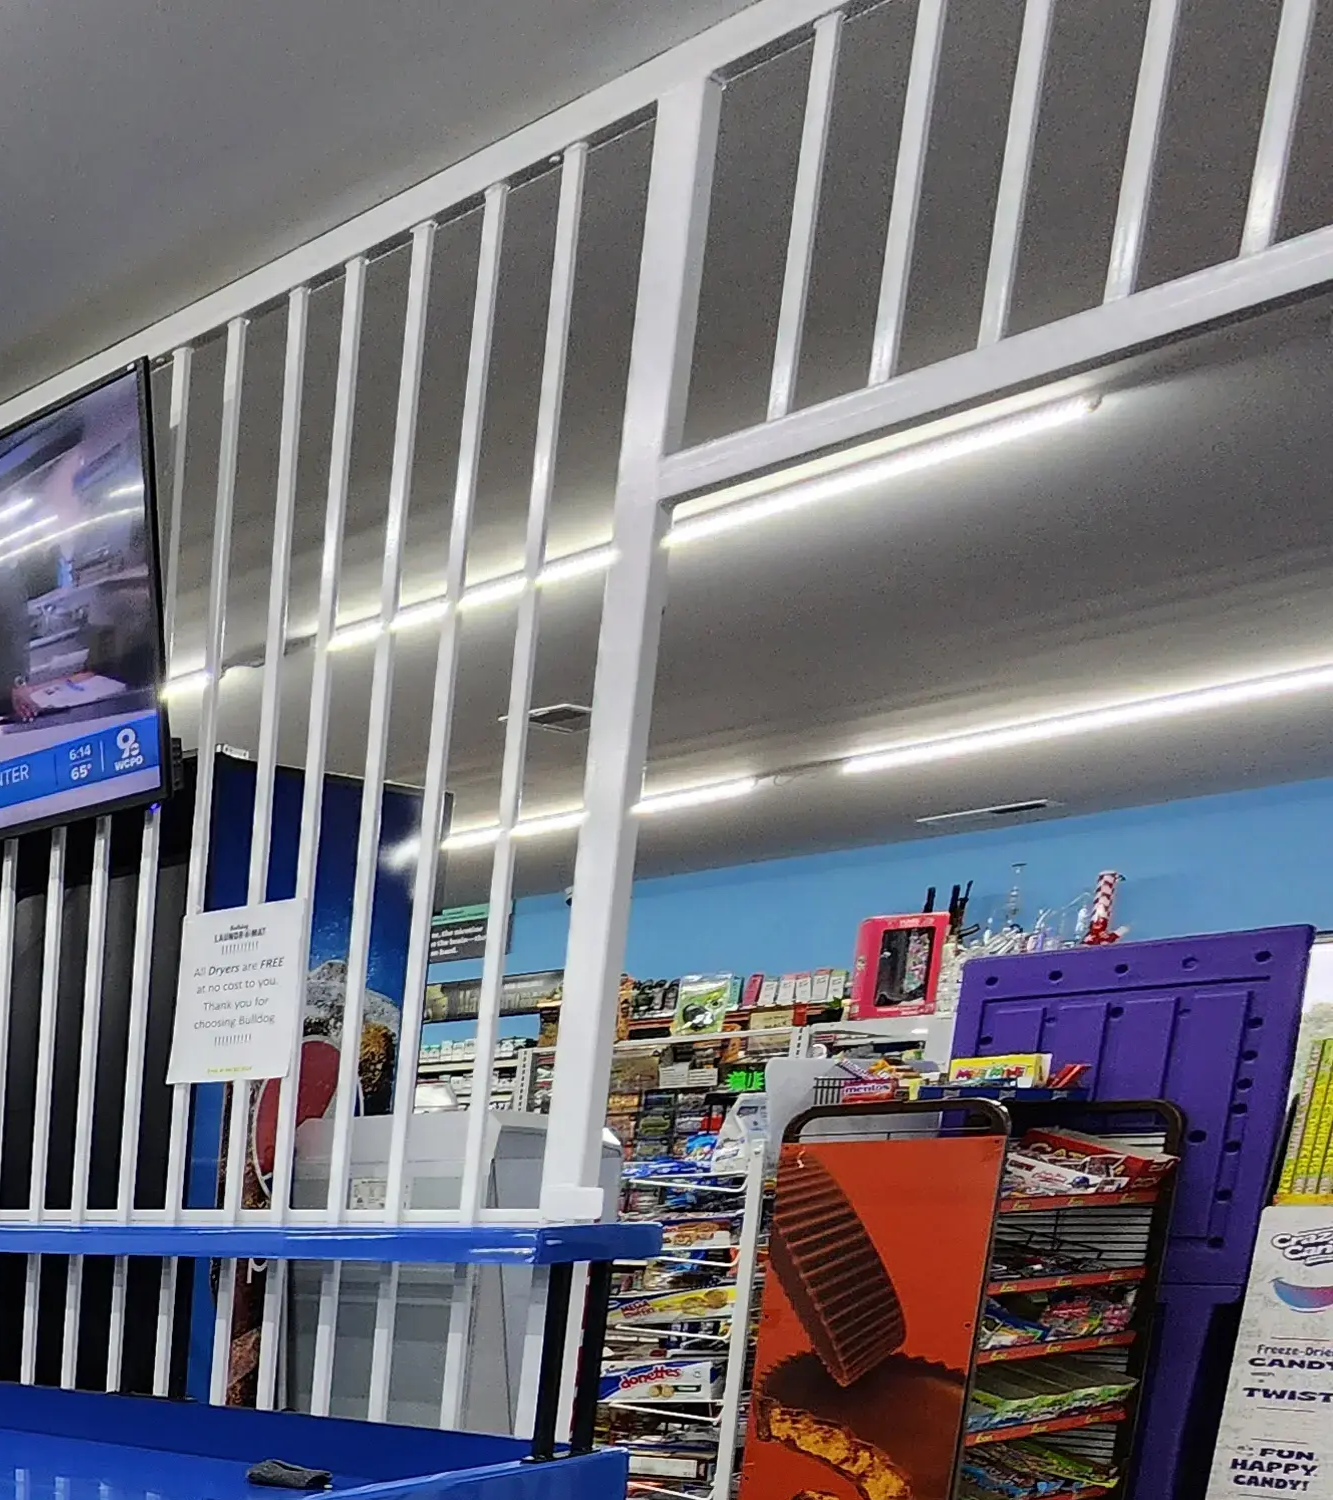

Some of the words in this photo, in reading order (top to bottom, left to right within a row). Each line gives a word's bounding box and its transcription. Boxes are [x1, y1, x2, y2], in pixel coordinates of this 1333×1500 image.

[113, 754, 144, 772] WCPO
[208, 964, 240, 976] Dryers
[242, 963, 257, 972] are
[259, 956, 285, 970] FREE
[196, 985, 206, 994] at
[208, 984, 221, 992] no
[223, 981, 243, 991] cost
[245, 980, 255, 988] to
[203, 1001, 232, 1011] Thank
[234, 1000, 252, 1010] you
[255, 996, 269, 1006] for
[194, 1018, 236, 1030] choosing
[238, 1013, 276, 1025] Bulldog
[845, 1083, 890, 1094] mentos
[1271, 1232, 1333, 1249] Craz
[1284, 1244, 1333, 1261] Can
[1257, 1343, 1333, 1357] Freeze-Drie
[621, 1364, 681, 1389] donettes
[1233, 1474, 1310, 1491] CANDY!
